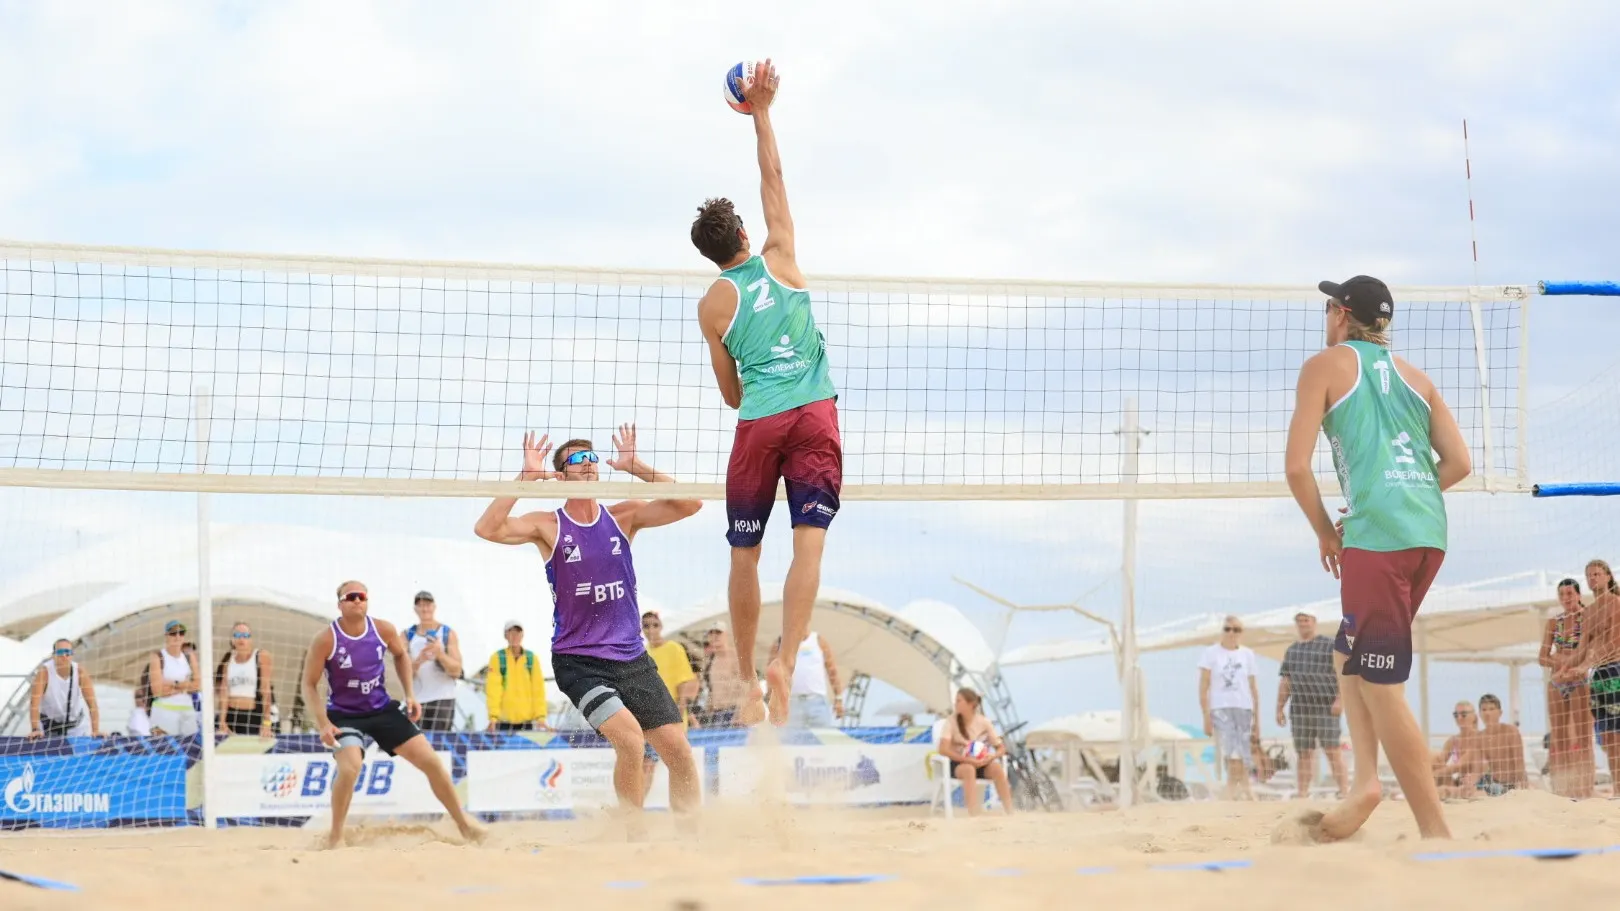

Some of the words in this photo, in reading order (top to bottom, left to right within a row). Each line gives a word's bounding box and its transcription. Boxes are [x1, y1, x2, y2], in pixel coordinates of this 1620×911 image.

[746, 277, 775, 313] 2
[761, 359, 811, 374] ОЛЕЙГРА
[1373, 360, 1389, 395] 1
[610, 536, 622, 555] 2
[594, 580, 625, 603] ВТБ
